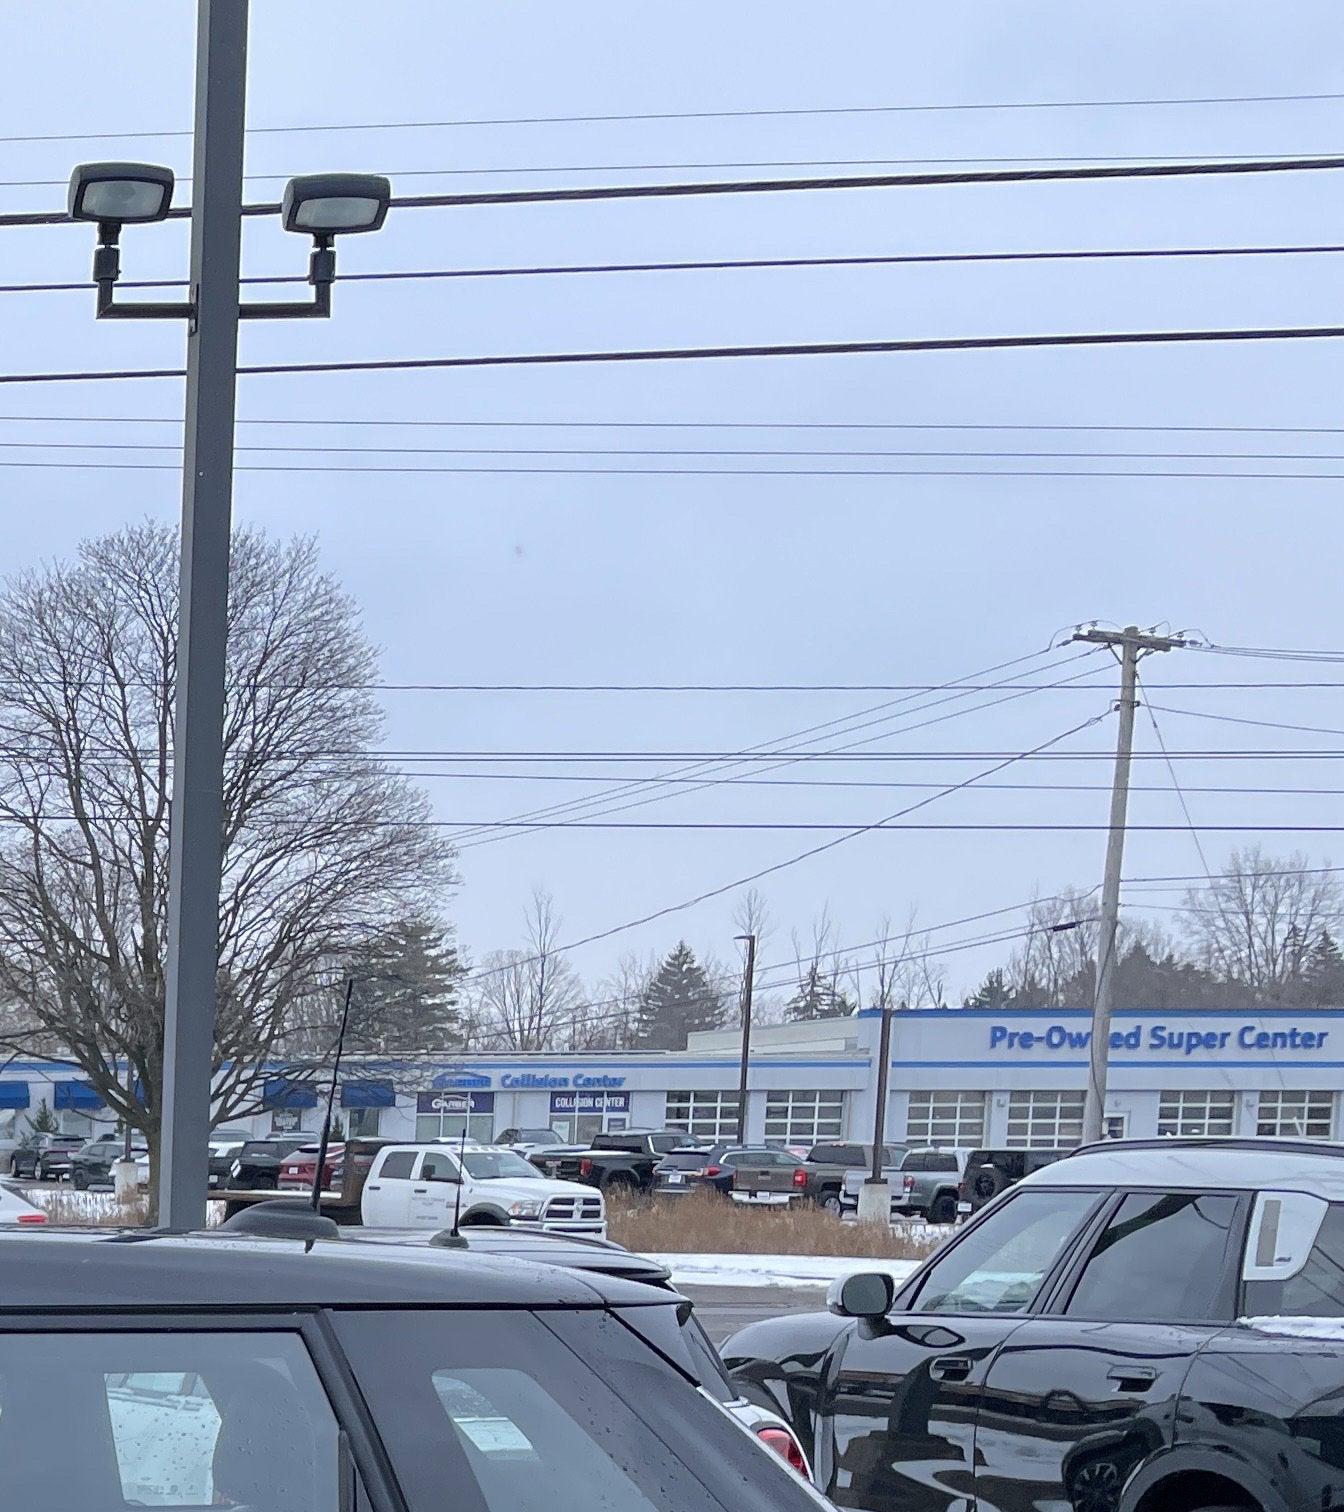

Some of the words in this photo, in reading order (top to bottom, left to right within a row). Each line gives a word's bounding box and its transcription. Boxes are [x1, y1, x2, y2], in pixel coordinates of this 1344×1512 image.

[989, 1024, 1142, 1050] Pre-Owed
[1148, 1024, 1231, 1056] Super
[1237, 1025, 1330, 1050] Center
[500, 1073, 570, 1089] Collision
[572, 1073, 627, 1089] Center
